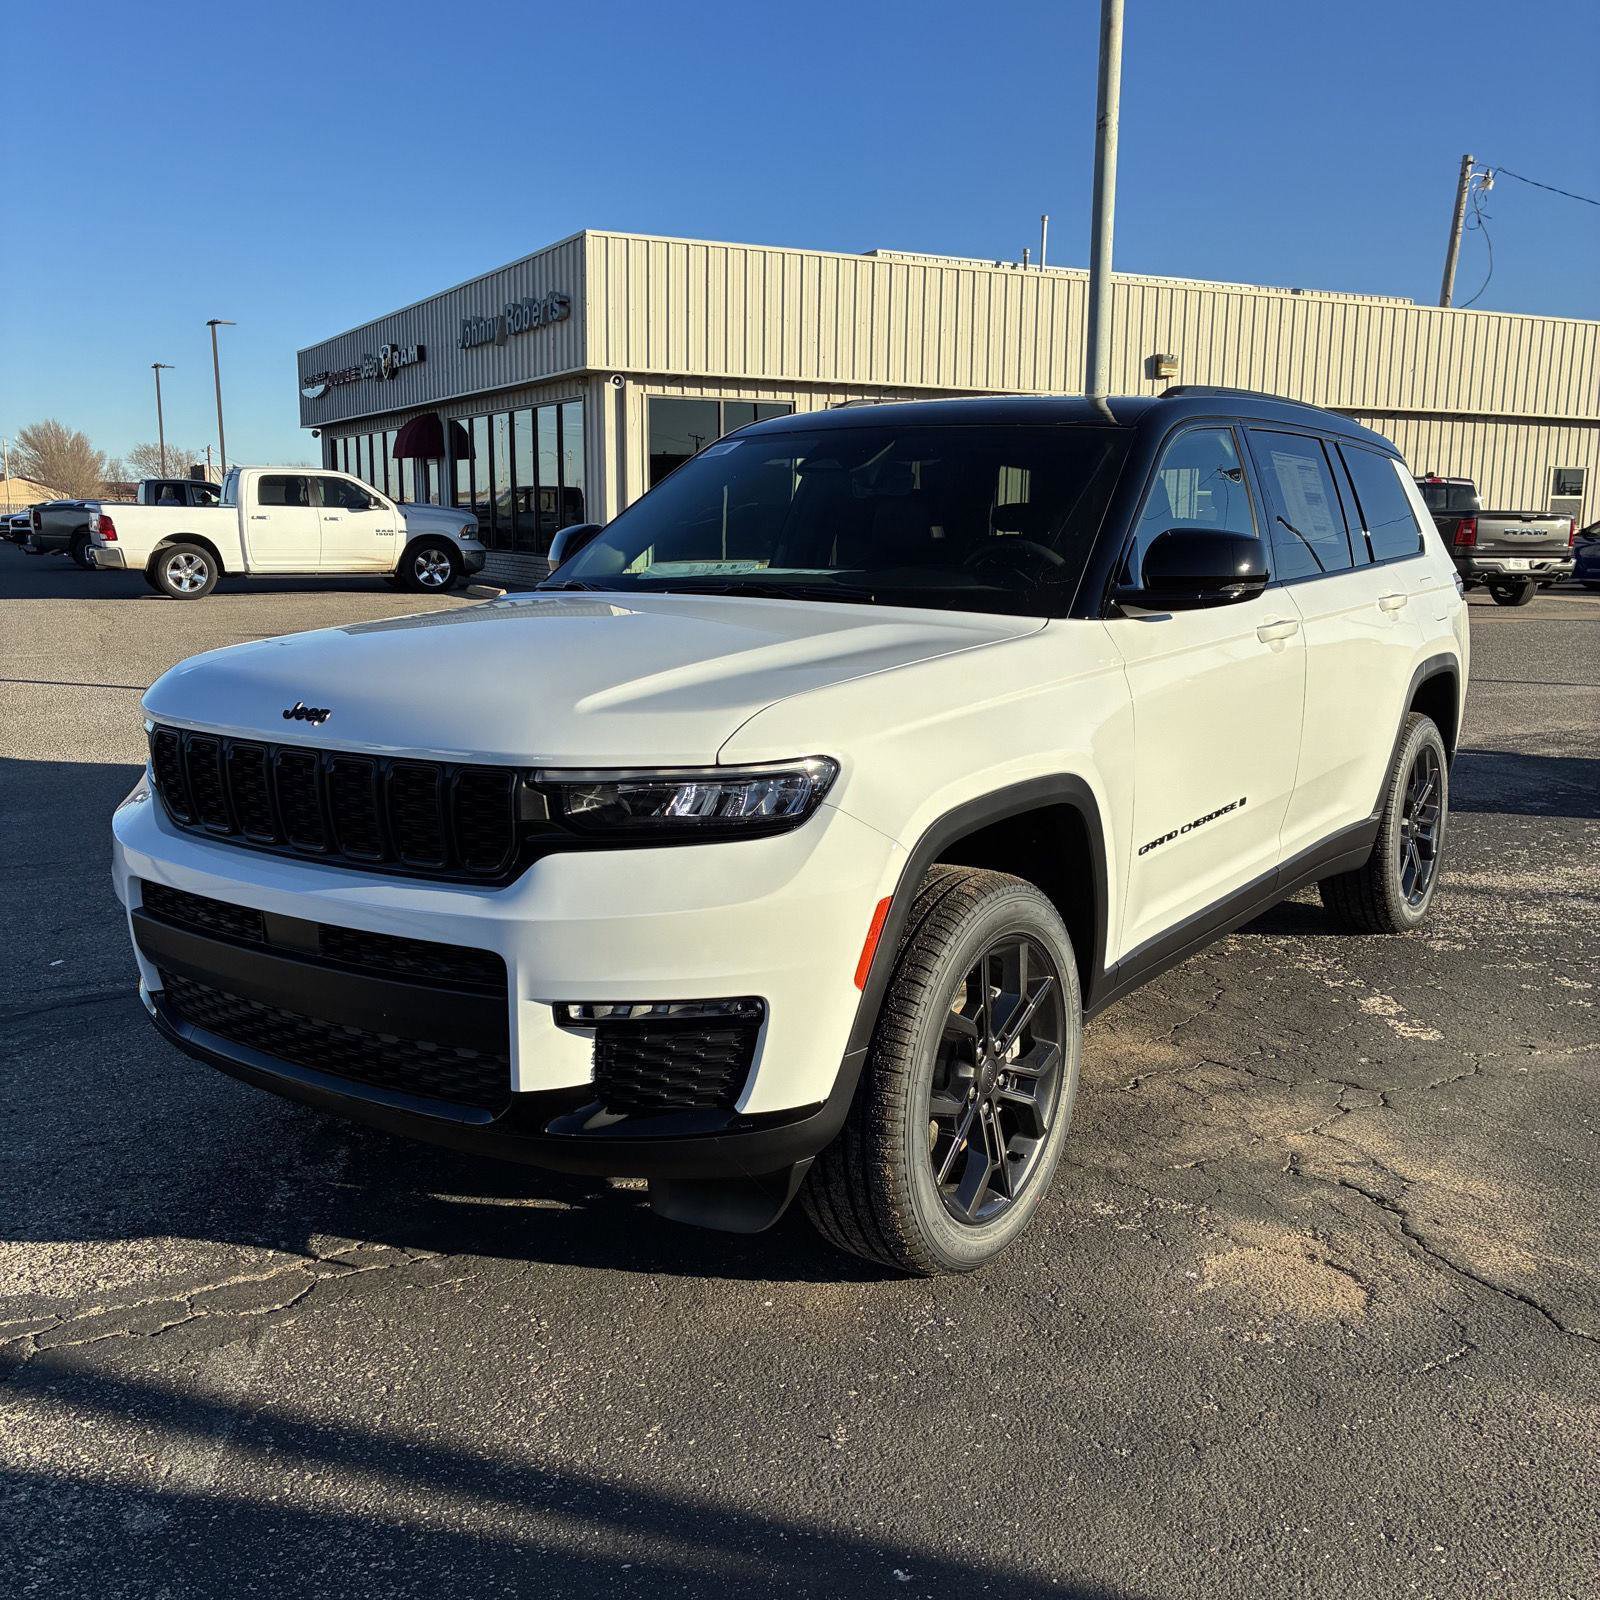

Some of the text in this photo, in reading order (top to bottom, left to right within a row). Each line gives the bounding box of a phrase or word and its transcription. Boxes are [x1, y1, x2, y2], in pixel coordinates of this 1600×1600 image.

[457, 291, 567, 349] Johnny Roberts
[391, 344, 424, 369] RAM
[1504, 528, 1548, 536] RAM
[282, 701, 331, 726] Jeep
[1138, 801, 1238, 856] GRAND CHEROKEE
